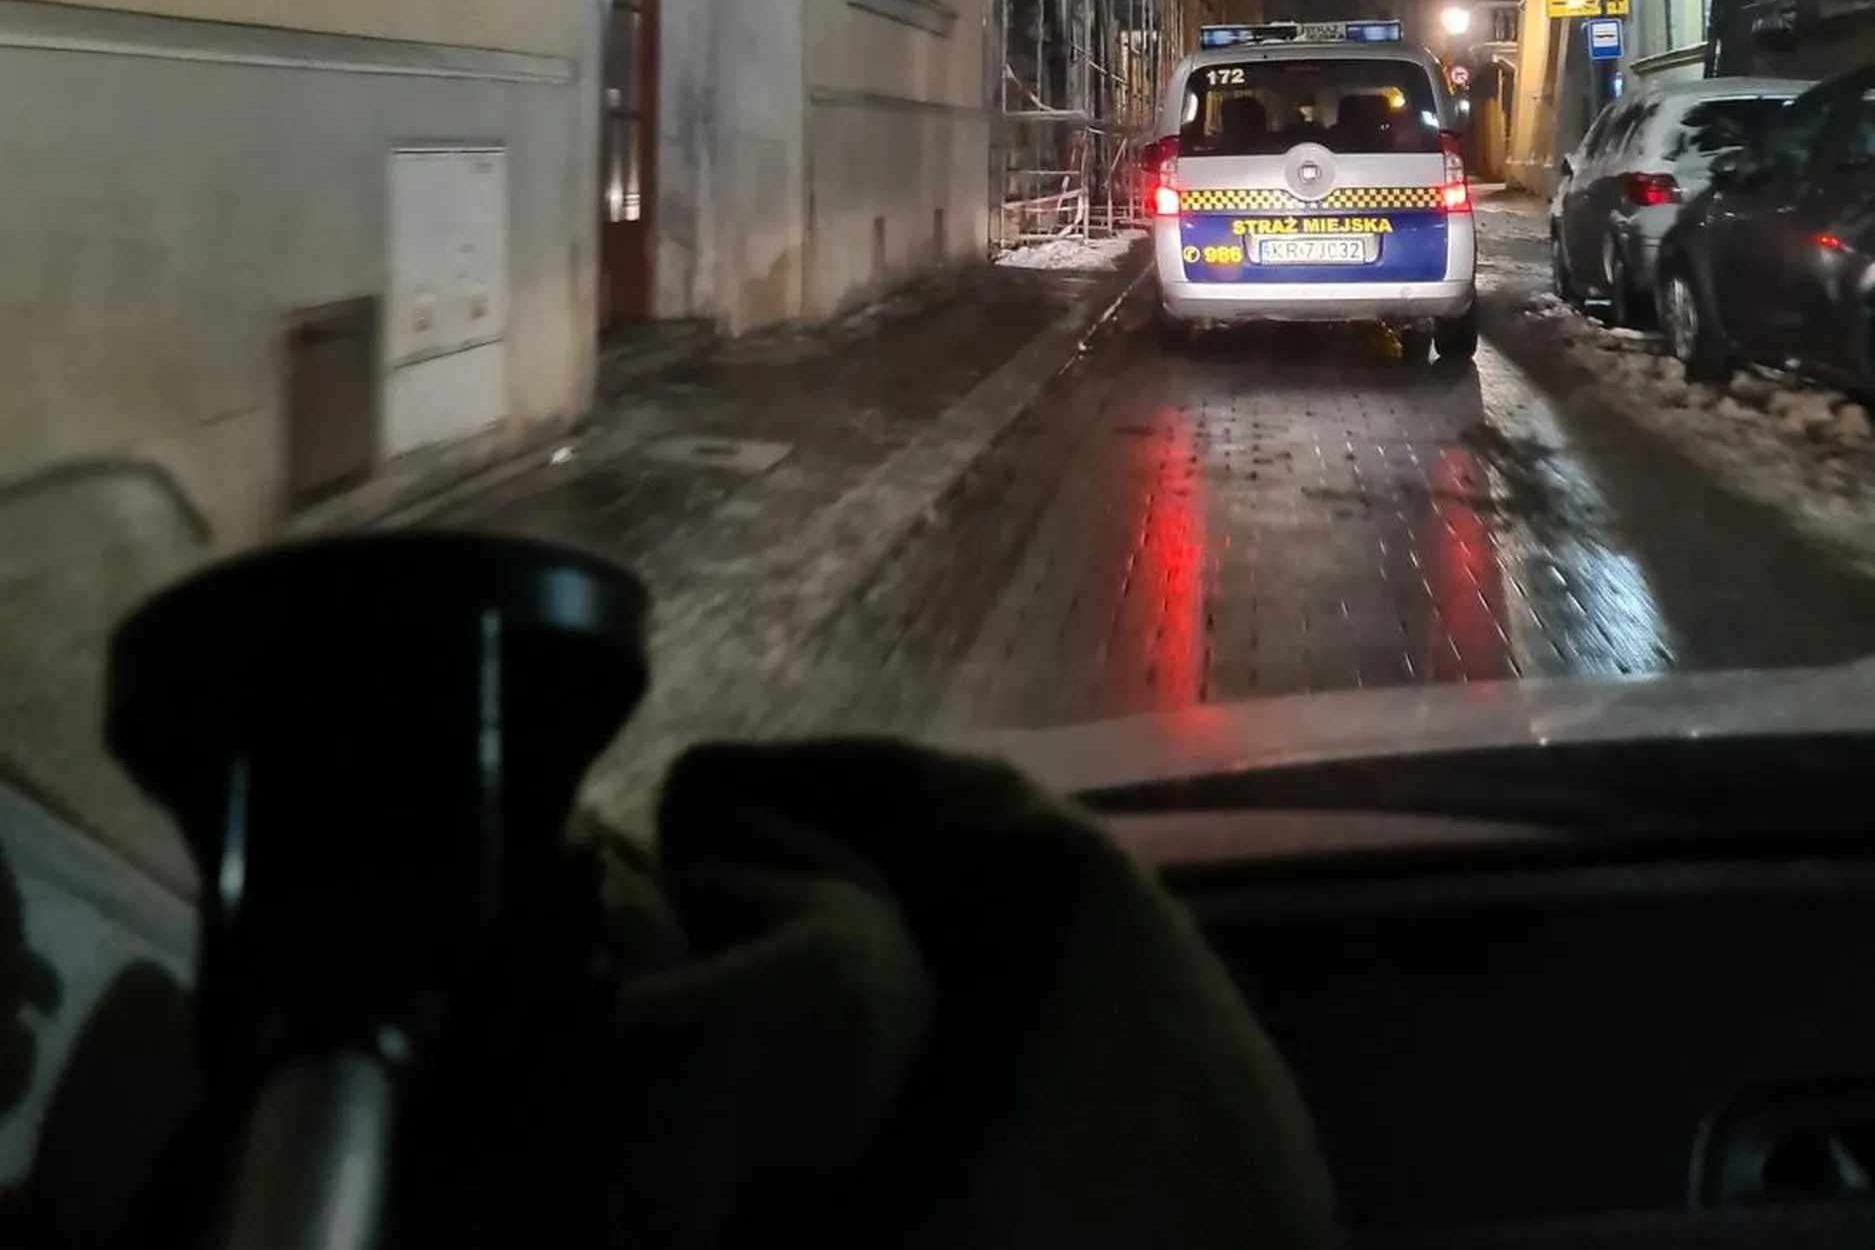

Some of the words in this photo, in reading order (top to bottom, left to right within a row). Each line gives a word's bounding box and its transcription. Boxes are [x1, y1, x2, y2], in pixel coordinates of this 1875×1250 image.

[1206, 69, 1245, 85] 172
[1233, 217, 1298, 235] STRAŻ
[1303, 218, 1393, 233] MIEJSKA
[1204, 246, 1243, 263] 986
[1271, 242, 1299, 258] KR
